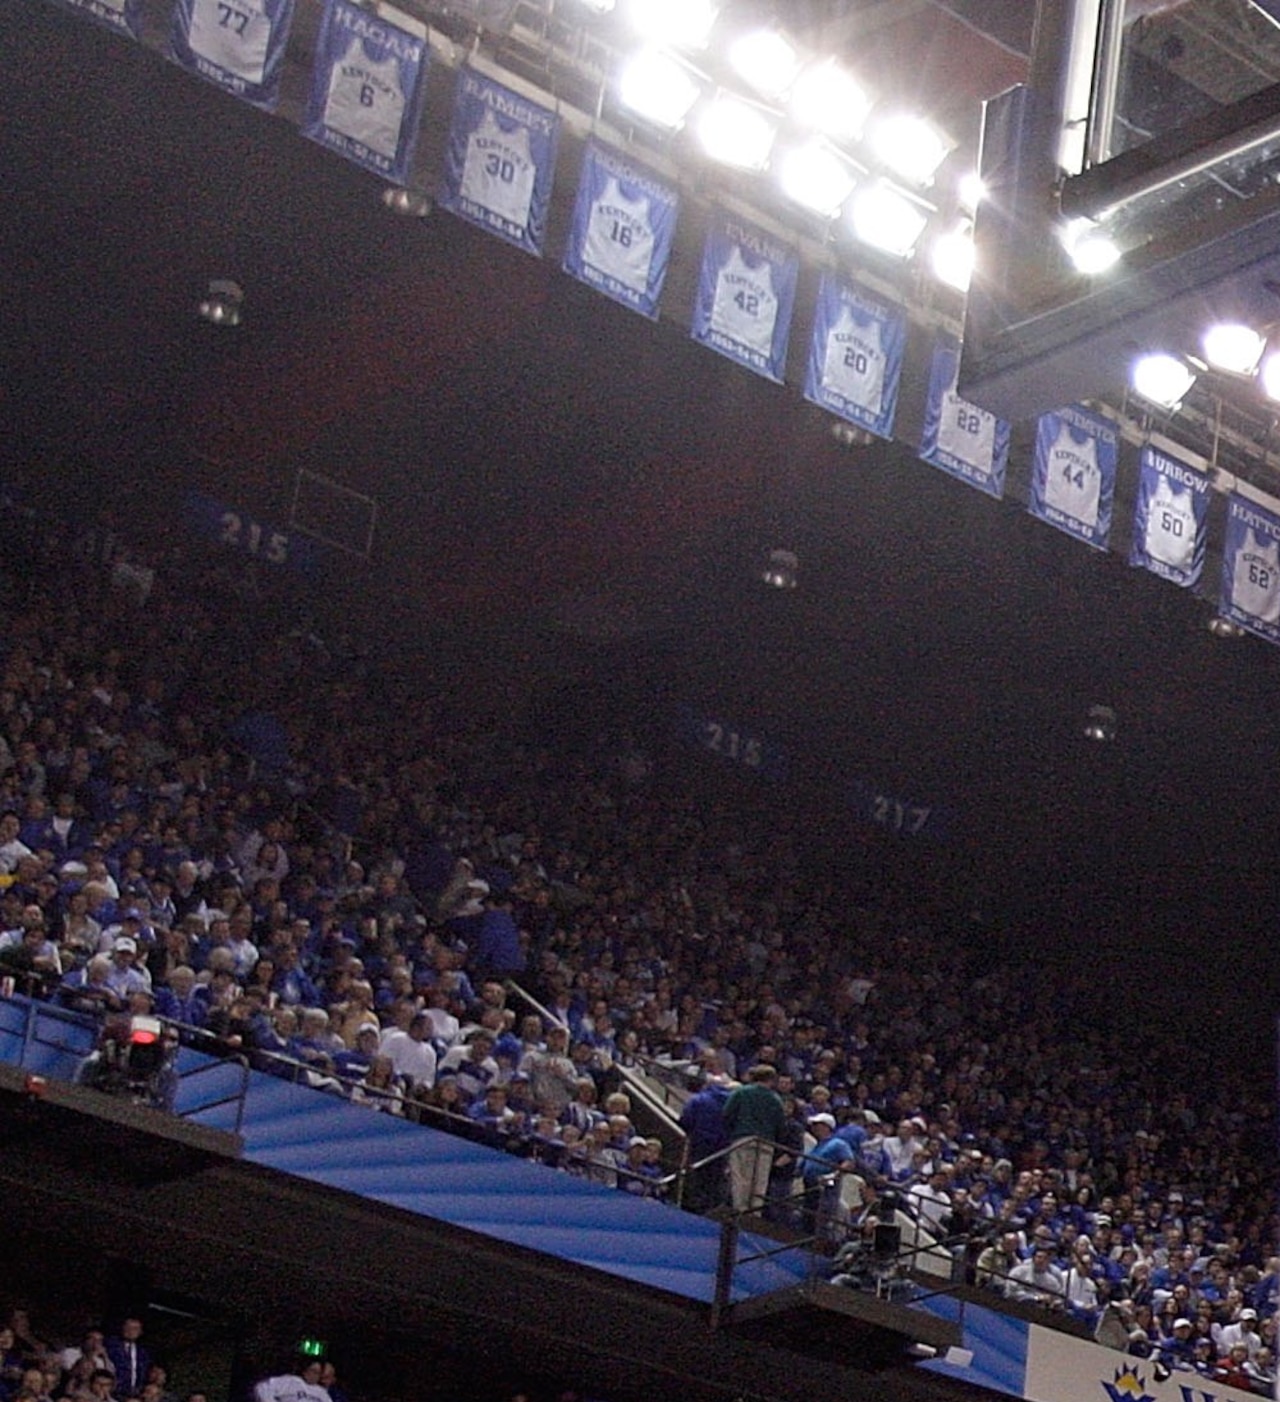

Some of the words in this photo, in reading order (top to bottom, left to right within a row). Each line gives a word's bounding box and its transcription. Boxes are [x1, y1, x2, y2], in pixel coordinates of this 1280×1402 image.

[217, 2, 249, 39] 77
[359, 83, 375, 108] 6
[485, 153, 515, 184] 30
[610, 220, 633, 248] 16
[733, 289, 760, 317] 42
[844, 345, 868, 376] 20
[956, 408, 981, 435] 22
[1061, 464, 1086, 490] 44
[223, 512, 288, 564] 215
[1160, 511, 1184, 538] 50
[1248, 564, 1270, 591] 52
